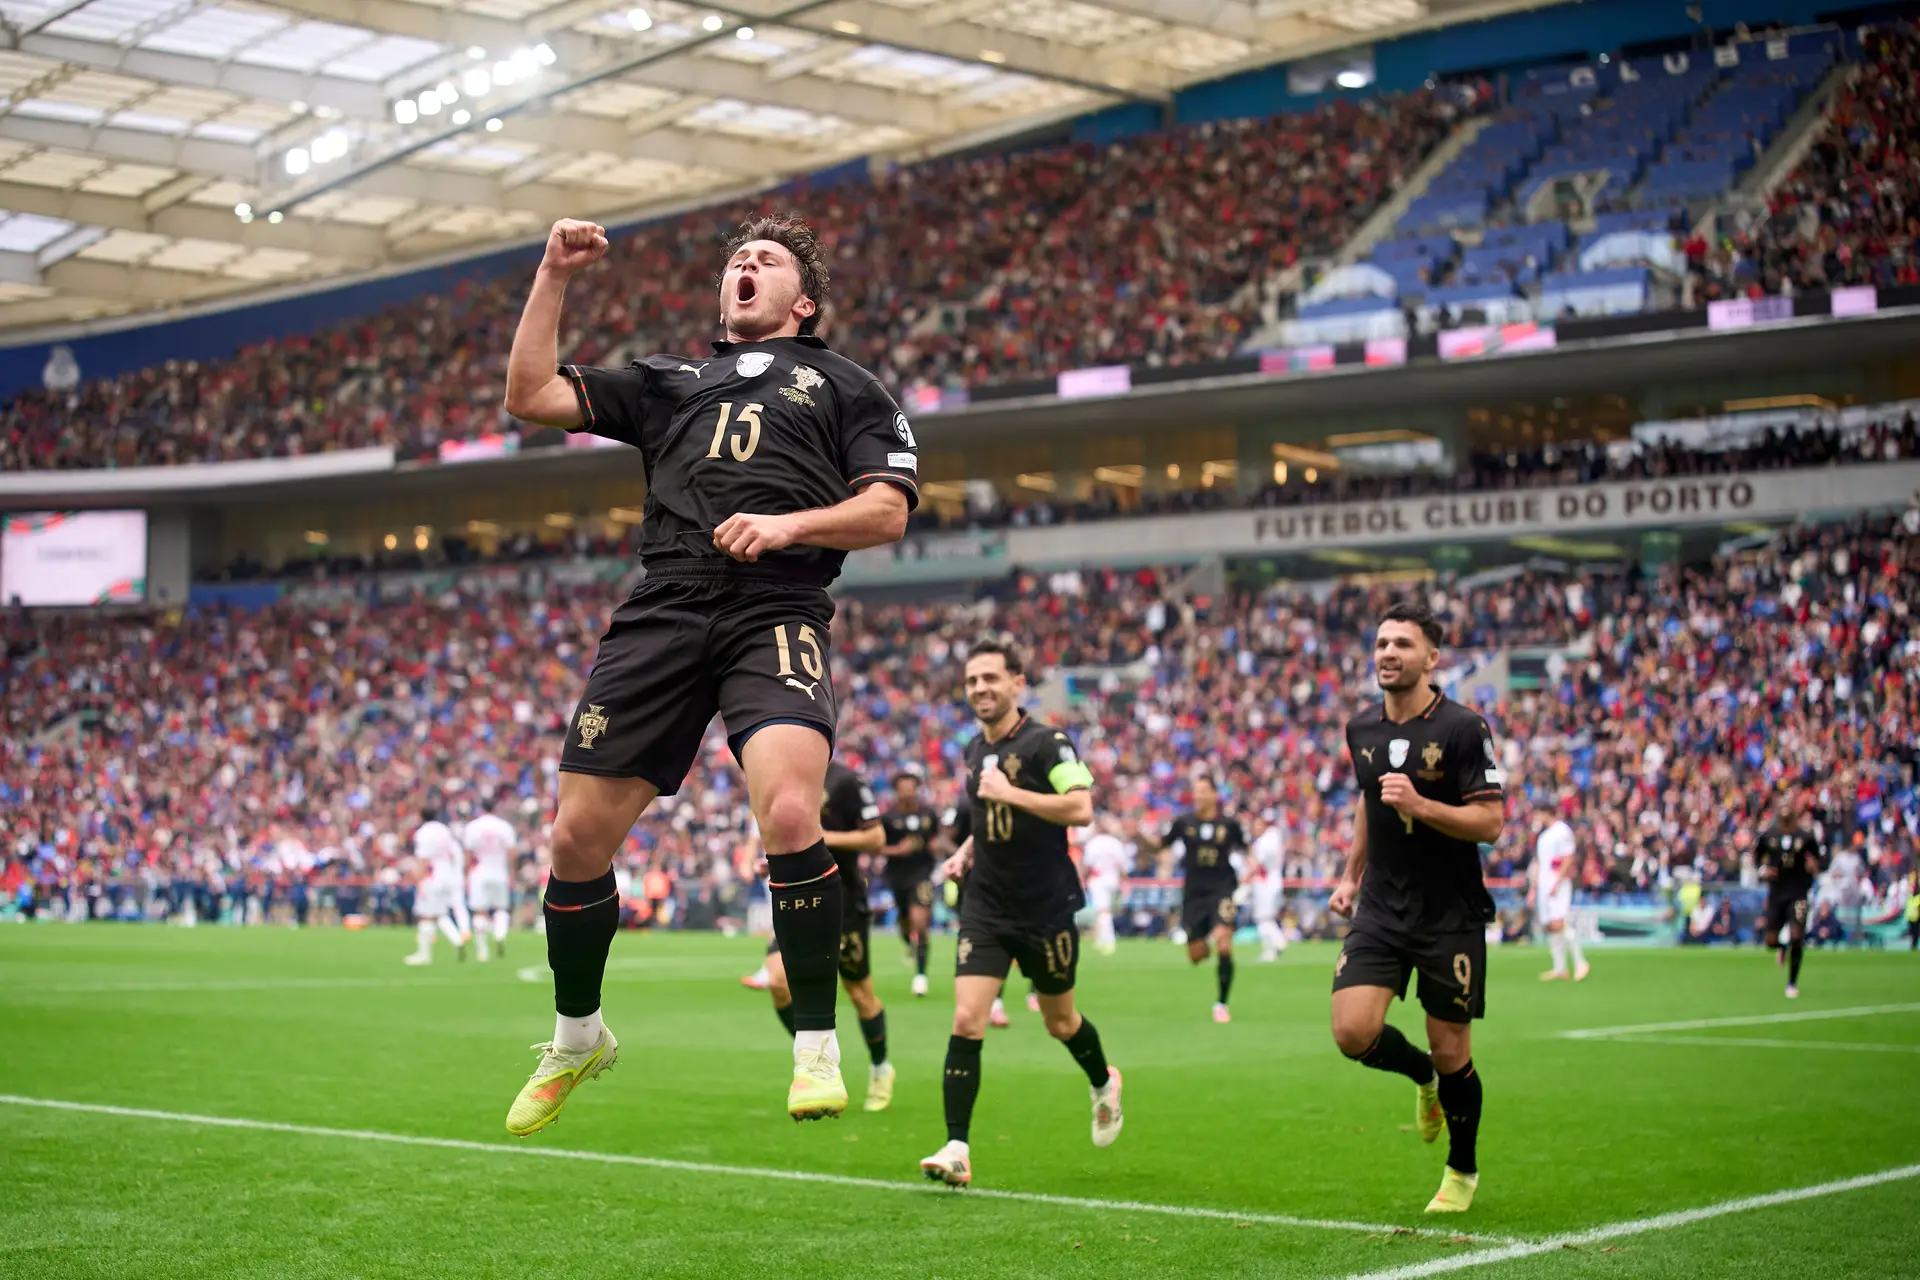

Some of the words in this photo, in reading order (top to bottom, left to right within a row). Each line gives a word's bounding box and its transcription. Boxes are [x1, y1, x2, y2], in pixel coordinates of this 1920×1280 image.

[705, 402, 763, 463] 15
[1254, 508, 1408, 541] FUTEBOL
[1424, 496, 1541, 530] CLUBE
[1557, 490, 1608, 520] DO
[1624, 481, 1754, 516] PORTO
[773, 623, 823, 680] 15
[986, 800, 1013, 842] 10
[1042, 929, 1072, 973] 10
[1453, 952, 1472, 996] 9
